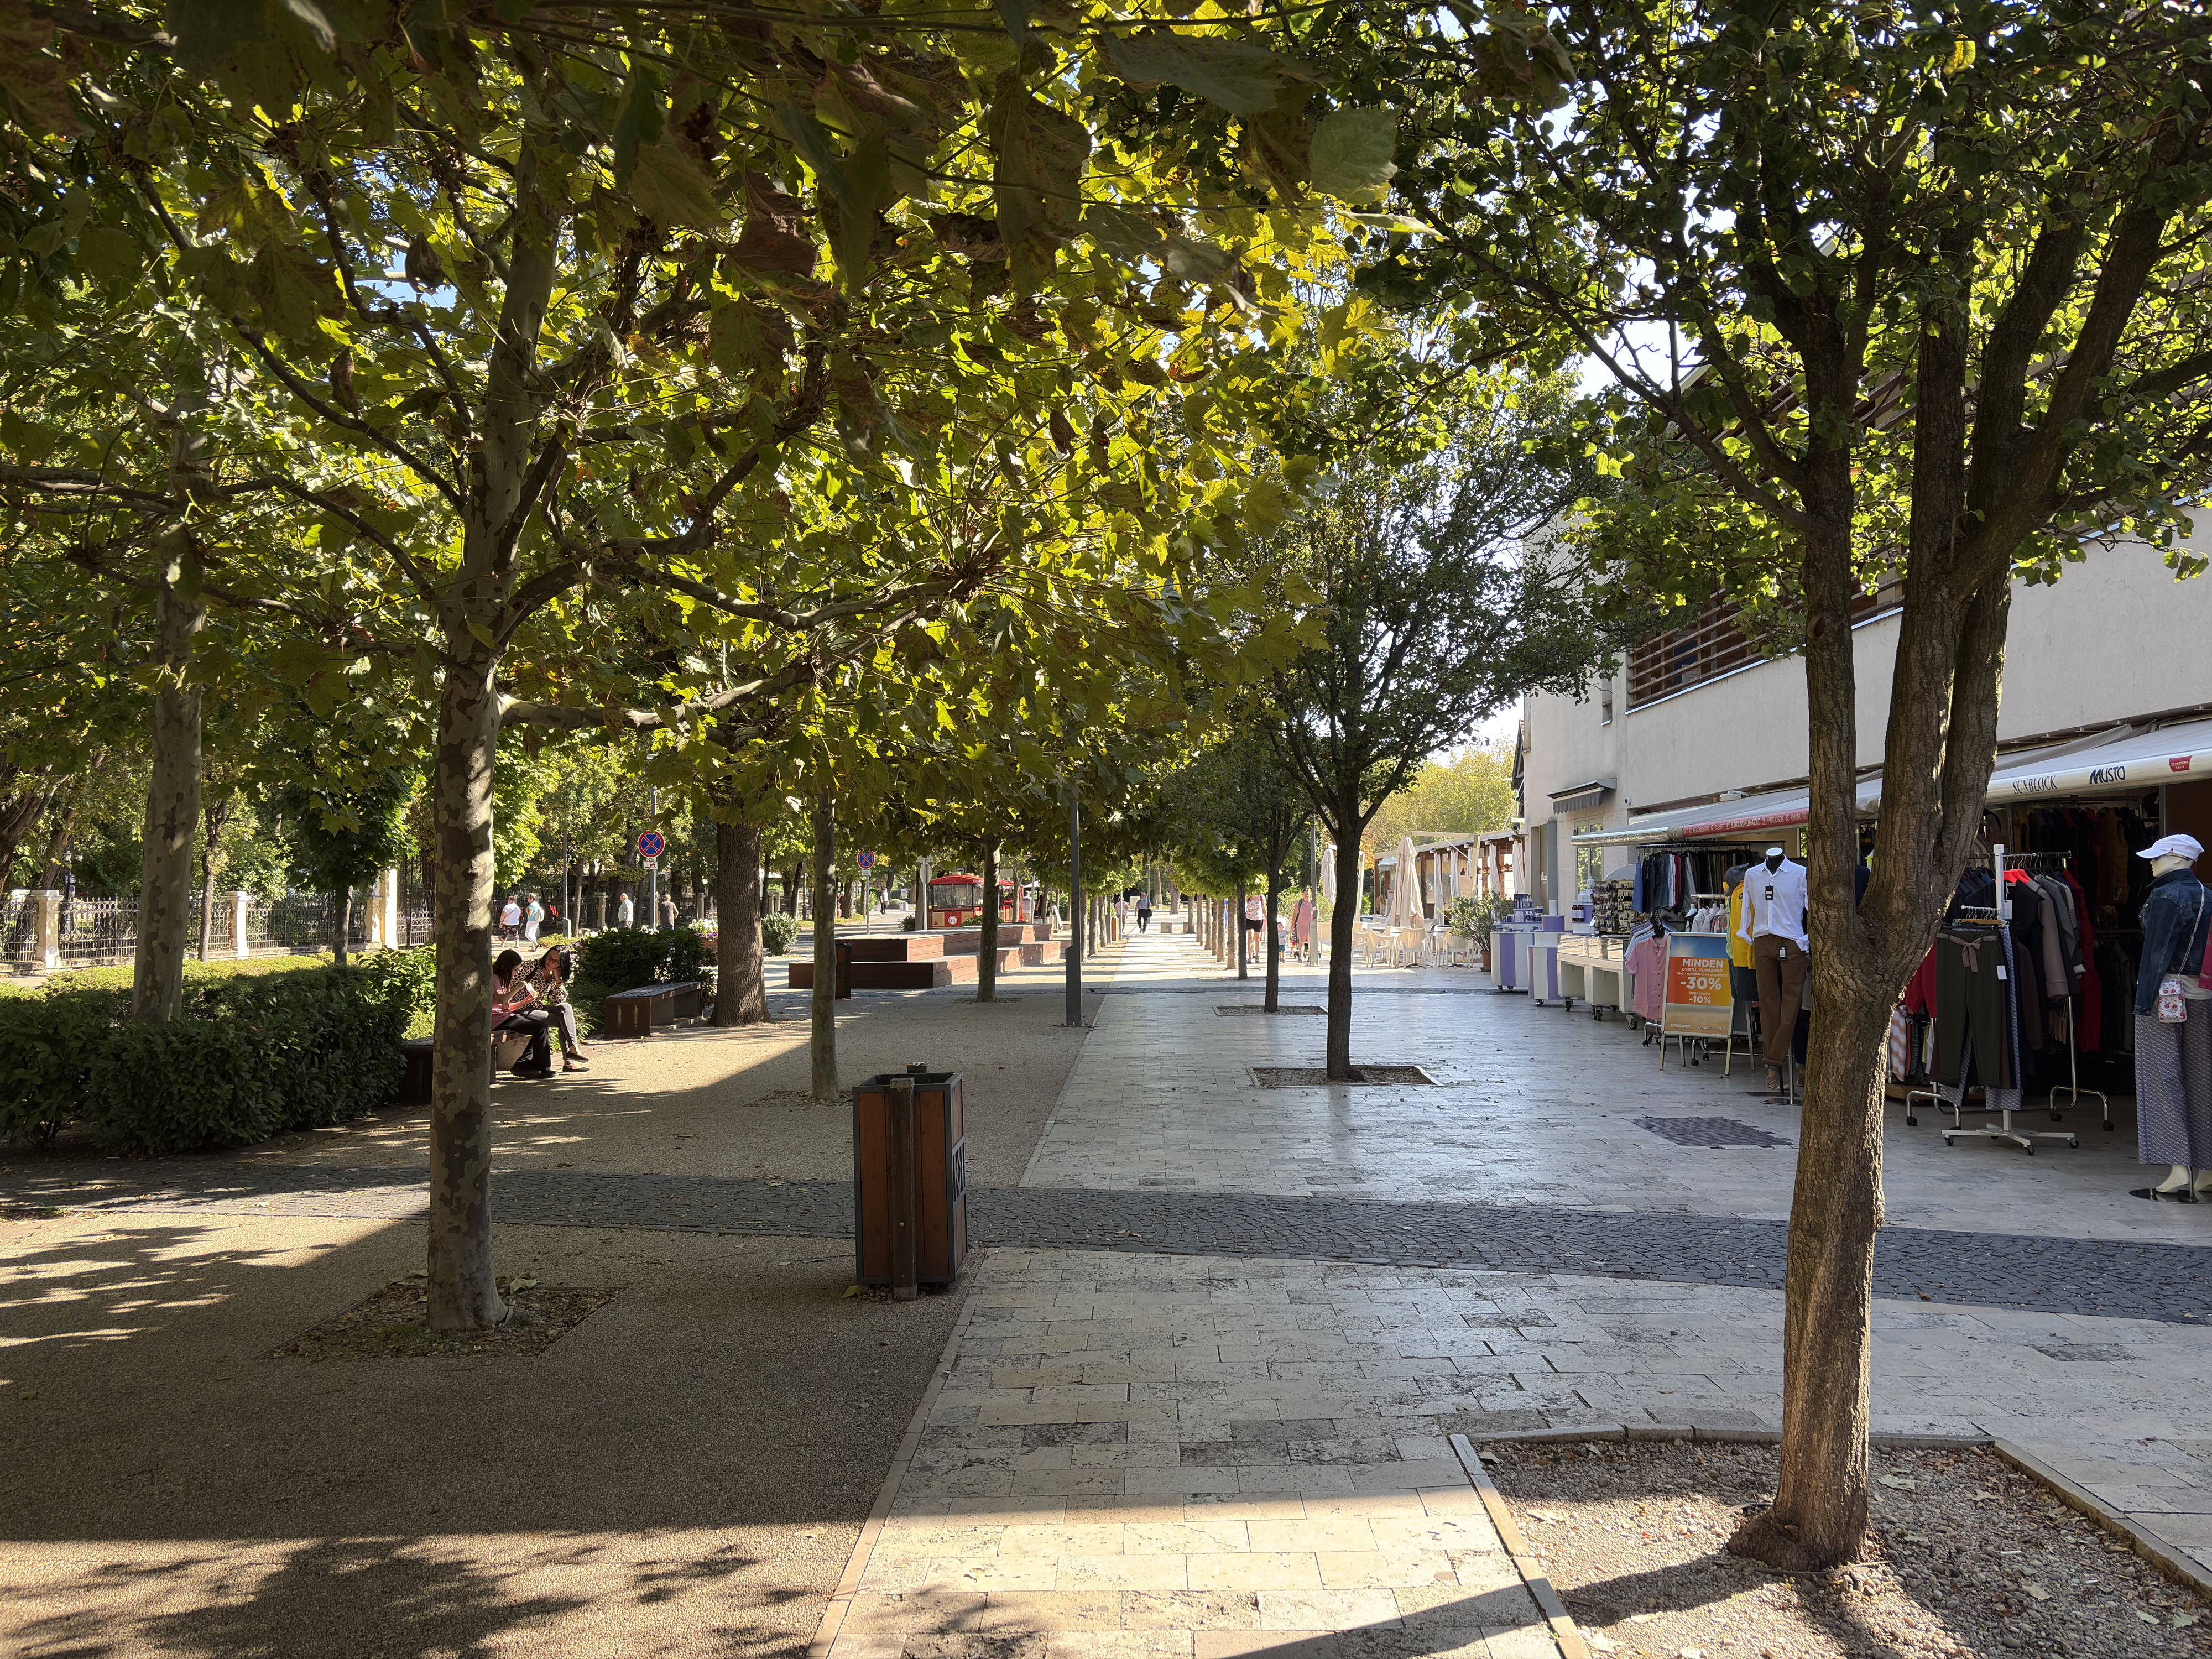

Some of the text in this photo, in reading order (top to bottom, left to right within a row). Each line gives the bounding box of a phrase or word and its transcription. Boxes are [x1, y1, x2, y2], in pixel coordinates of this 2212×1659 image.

[2089, 765, 2126, 785] MUSTO
[2013, 775, 2058, 794] SUNBLOCK
[1731, 817, 1760, 828] STRANDRUHÁZAT
[1767, 815, 1785, 824] PAPUCSOK
[1682, 958, 1724, 968] MINDEN
[1681, 977, 1722, 990] -30%
[1689, 995, 1712, 1004] -10%
